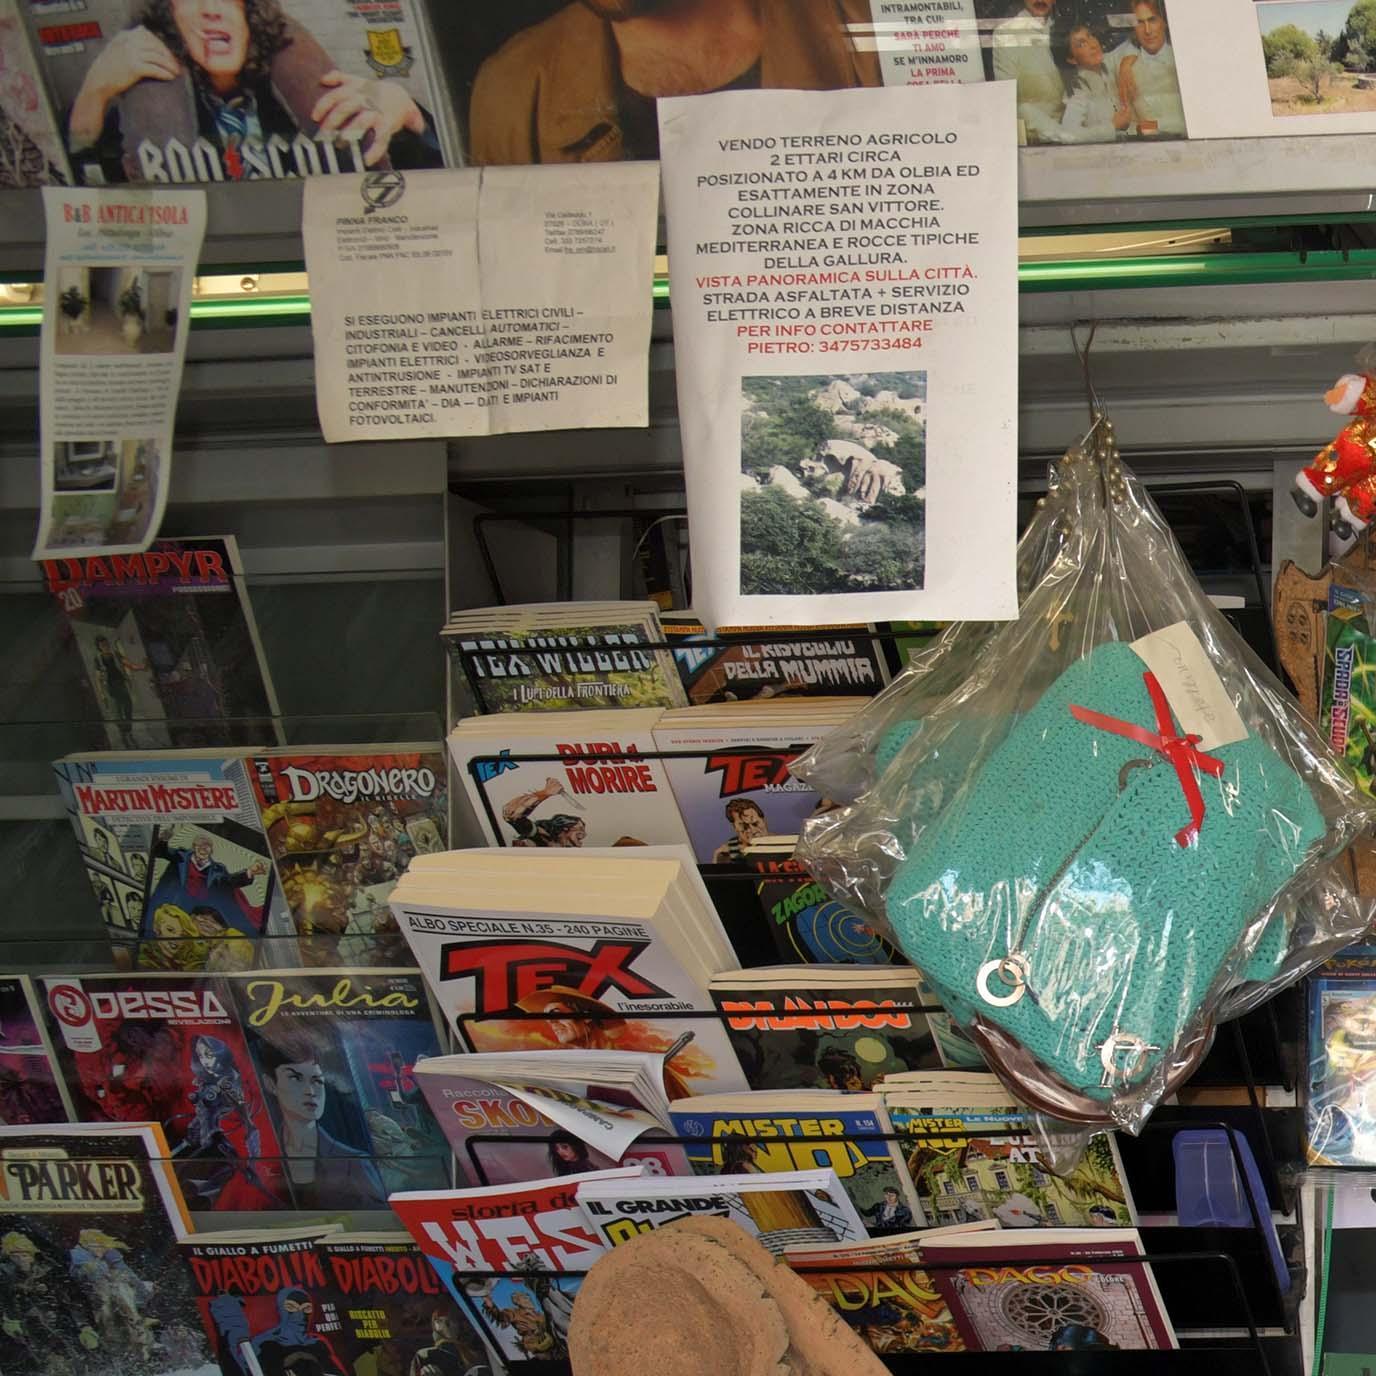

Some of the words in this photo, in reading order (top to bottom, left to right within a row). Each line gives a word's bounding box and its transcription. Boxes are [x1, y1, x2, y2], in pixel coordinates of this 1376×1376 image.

[719, 137, 776, 151] VENDO
[780, 135, 862, 148] TERRENO
[867, 132, 957, 145] AGRICOLO
[770, 154, 779, 166] 2
[785, 152, 843, 165] ETTARI
[847, 150, 901, 162] CIRCA
[697, 172, 808, 187] POSIZIONATO
[812, 171, 823, 182] A
[828, 170, 838, 181] 4
[841, 169, 866, 180] KM
[871, 168, 895, 178] DA
[900, 166, 952, 177] OLBIA
[956, 165, 980, 176] ED
[738, 186, 860, 202] ESATTAMENTE
[865, 185, 882, 196] IN
[886, 183, 934, 195] ZONA
[728, 204, 825, 219] COLLINARE
[830, 202, 864, 215] SAN
[868, 200, 944, 213] VITTORE.
[732, 223, 779, 236] ZONA
[783, 221, 836, 235] RICCA
[840, 220, 857, 232] DI
[860, 217, 940, 231] MACCHIA
[696, 238, 829, 255] MEDITERRANEA
[833, 238, 843, 248] E
[848, 235, 906, 248] ROCCE
[911, 233, 979, 245] TIPICHE
[764, 256, 819, 269] DELLA
[823, 253, 907, 267] GALLURA.
[696, 276, 742, 289] VISTA
[747, 272, 860, 286] PANORAMICA
[865, 269, 920, 282] SULLA
[924, 264, 977, 280] CITTÀ.
[703, 292, 770, 305] STRADA
[774, 288, 872, 303] ASFALTATA
[891, 284, 969, 299] SERVIZIO
[344, 316, 356, 326] SI
[358, 314, 424, 326] ESEGUONO
[428, 312, 476, 323] IMPIANTI
[482, 310, 539, 320] ELETTRICI
[542, 308, 574, 318] CIVILI
[707, 308, 800, 322] ELETTRICO
[805, 308, 816, 319] A
[821, 305, 876, 318] BREVE
[880, 302, 965, 315] DISTANZA
[737, 325, 771, 337] PER
[776, 324, 816, 336] INFO
[820, 320, 933, 335] CONTATTARE
[748, 341, 814, 354] PIETRO:
[818, 338, 922, 352] 3475733484
[350, 414, 436, 426] FOTOVOLTAICI.
[42, 549, 229, 591] DAMPYR
[279, 765, 436, 802] DRAGONERO
[566, 765, 657, 794] MORIRE
[75, 785, 154, 816] MARTIN
[153, 782, 240, 812] MYSTÈRE
[409, 916, 438, 930] ALBO
[443, 918, 519, 935] SPECIALE
[522, 921, 552, 935] N.35
[566, 923, 588, 936] 240
[593, 924, 649, 938] PAGINE
[246, 979, 417, 1027] Julia
[8, 1160, 142, 1201] PARKER
